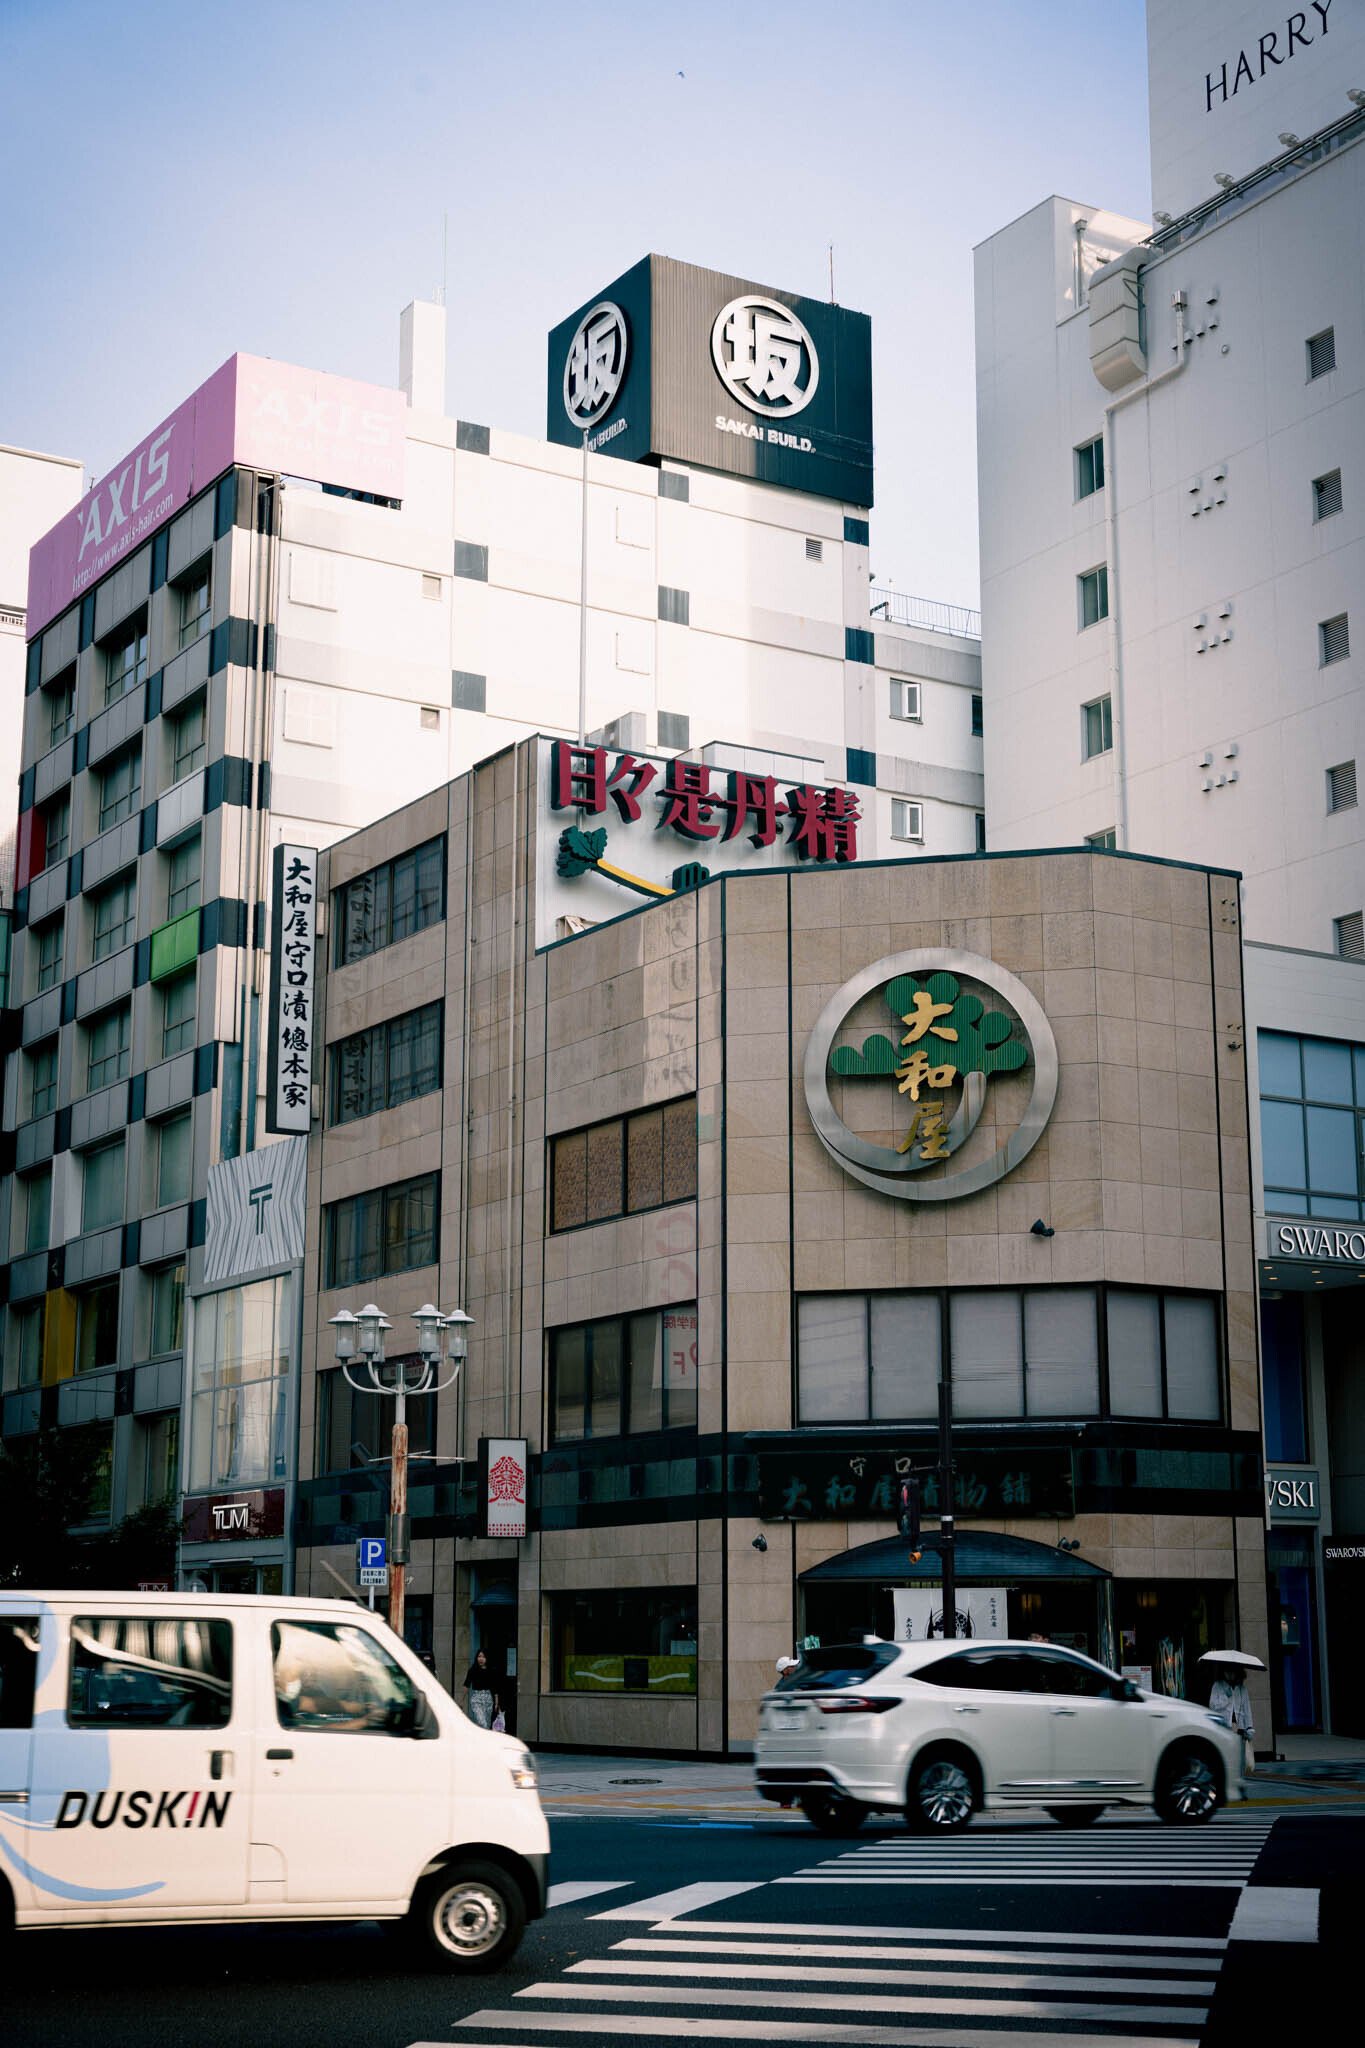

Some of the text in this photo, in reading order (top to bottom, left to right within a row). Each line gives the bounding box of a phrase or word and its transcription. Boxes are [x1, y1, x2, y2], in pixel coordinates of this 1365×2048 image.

[1204, 0, 1332, 113] HARRY
[715, 415, 764, 441] SAKAI
[552, 741, 863, 862] 日々是丹精
[895, 991, 959, 1159] 大和屋
[213, 1503, 249, 1530] TUMI
[367, 1542, 382, 1565] P
